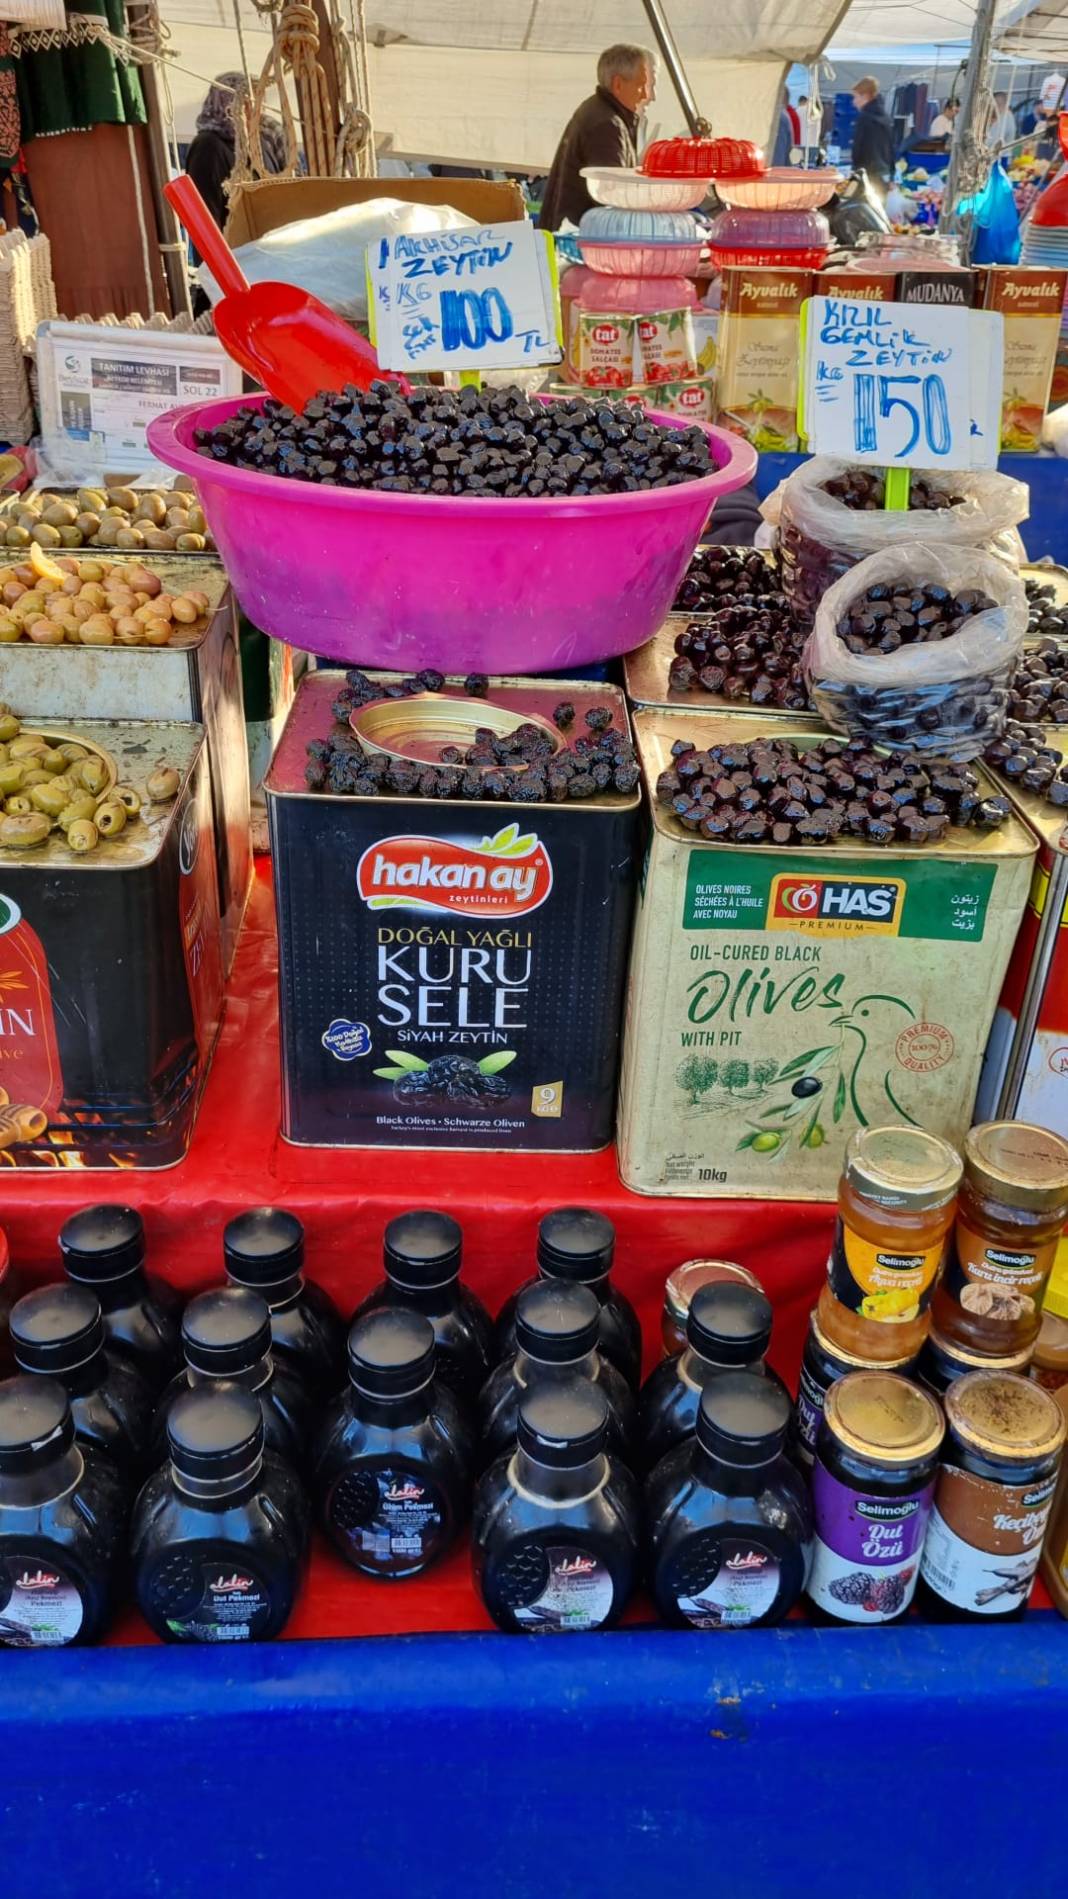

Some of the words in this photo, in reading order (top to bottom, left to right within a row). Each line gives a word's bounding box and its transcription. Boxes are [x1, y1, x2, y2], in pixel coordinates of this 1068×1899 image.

[740, 282, 798, 299] Ayvalık
[907, 282, 964, 303] MUDANYA
[1001, 281, 1059, 300] Ayvalık
[440, 288, 513, 352] 100
[823, 300, 891, 326] KIZIL
[595, 327, 617, 339] tat
[183, 386, 202, 396] SOL
[205, 387, 218, 396] 22
[853, 374, 951, 457] 150
[373, 855, 485, 889] hakan
[490, 866, 538, 902] ay
[695, 884, 722, 895] OLIVES
[723, 885, 752, 895] NOIRES
[449, 894, 508, 905] zeytinleri
[694, 895, 728, 907] SÉCHÉES
[728, 896, 734, 907] À
[735, 898, 765, 908] L'HUILE
[951, 894, 980, 905] زيتون
[693, 909, 712, 919] AVEC
[713, 909, 738, 919] NOYAU
[800, 920, 864, 931] PREMIUM
[951, 918, 975, 930] بزيت
[378, 926, 460, 947] DOĞAL
[467, 929, 532, 948] YAĞLI
[690, 945, 768, 960] OIL-CURED
[774, 946, 821, 961] BLACK
[378, 945, 532, 985] KURU
[687, 966, 846, 1024] Olives
[377, 983, 529, 1028] SELE
[448, 1030, 508, 1044] ZEYTİN
[681, 1031, 714, 1047] WITH
[719, 1031, 742, 1046] PIT
[901, 1024, 948, 1042] PREMIUM
[903, 1054, 945, 1070] QUALITY
[541, 1087, 555, 1105] 9
[376, 1115, 404, 1125] Black
[405, 1116, 436, 1126] Olives
[444, 1117, 490, 1127] Schwarze
[493, 1119, 525, 1129] Oliven
[698, 1168, 727, 1184] 10kg
[868, 1524, 904, 1539] Dut
